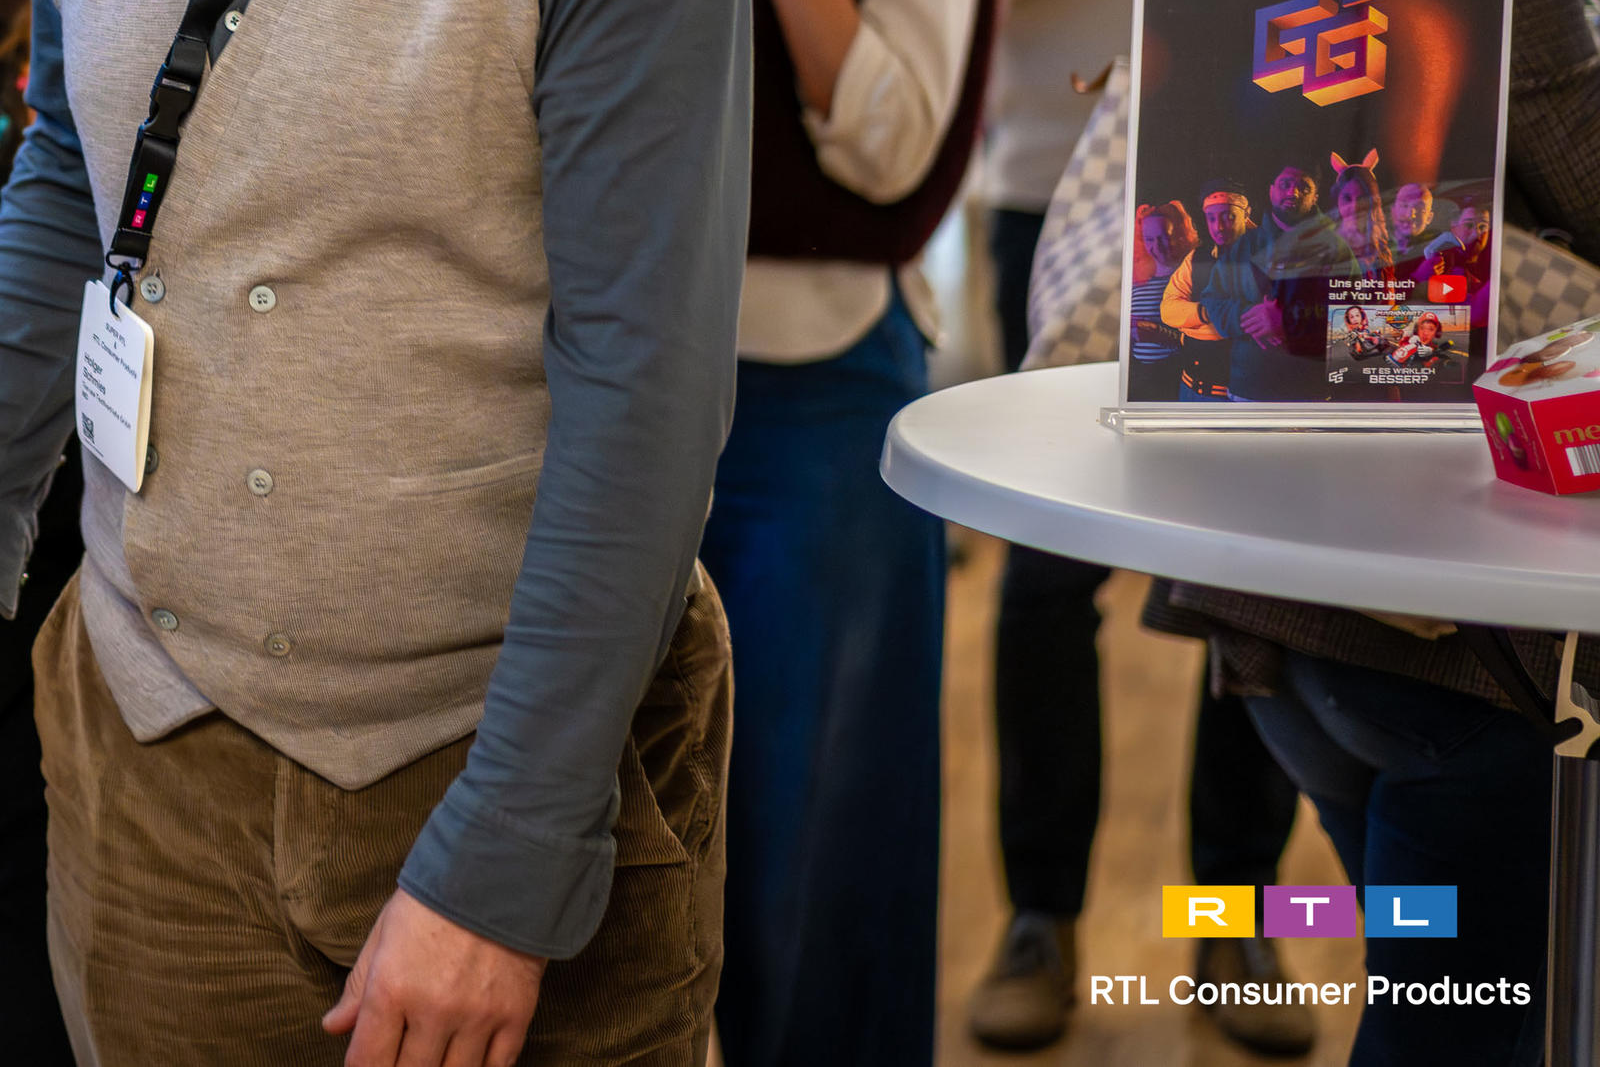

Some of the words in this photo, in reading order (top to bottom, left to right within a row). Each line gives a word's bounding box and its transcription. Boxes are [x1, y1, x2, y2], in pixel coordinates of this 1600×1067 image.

[1329, 279, 1352, 288] Uns
[1387, 279, 1415, 289] auch
[1328, 291, 1348, 300] auf
[1350, 292, 1372, 301] You
[1374, 292, 1406, 301] Tube!
[1369, 375, 1428, 384] BESSER?
